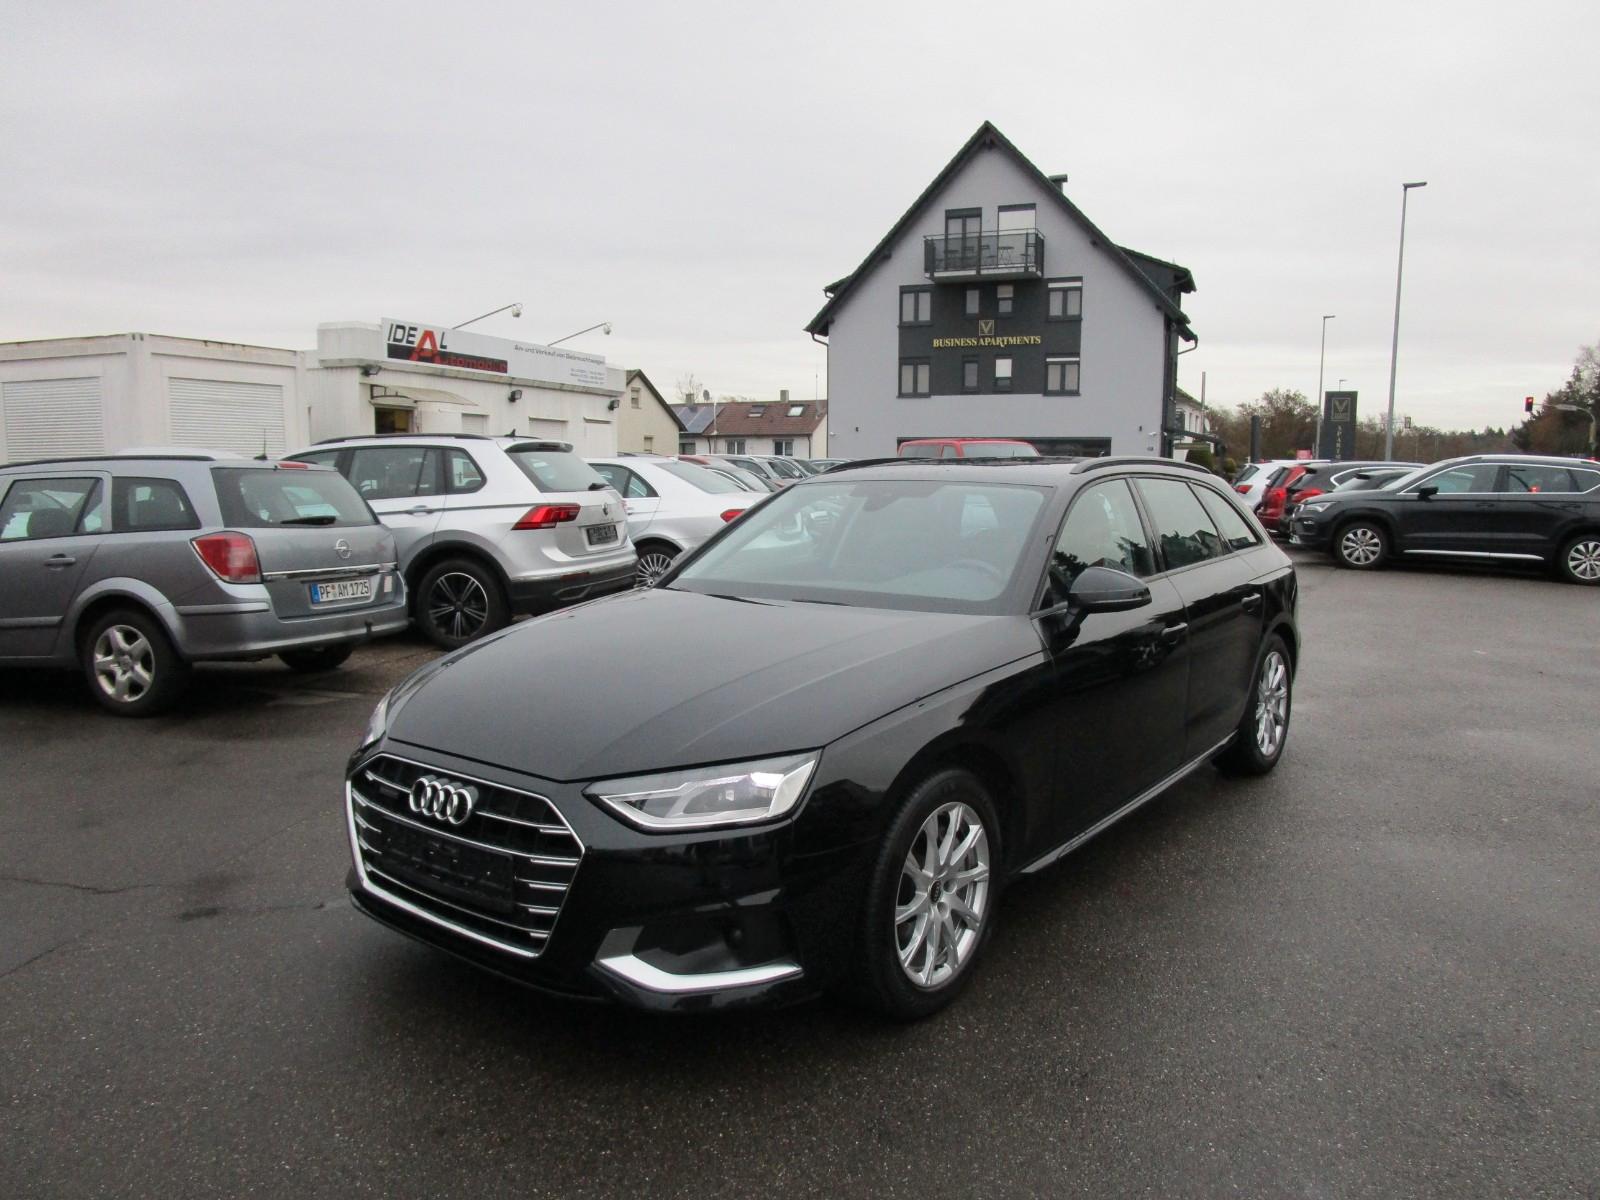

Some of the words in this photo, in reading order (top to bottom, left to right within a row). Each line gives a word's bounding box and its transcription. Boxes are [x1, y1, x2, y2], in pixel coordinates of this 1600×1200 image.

[388, 323, 447, 362] IDEAL
[933, 337, 977, 348] BUSINESS
[978, 336, 1041, 347] APARTMENTS
[319, 585, 331, 599] PF
[337, 583, 349, 597] AM
[349, 581, 369, 596] 1725
